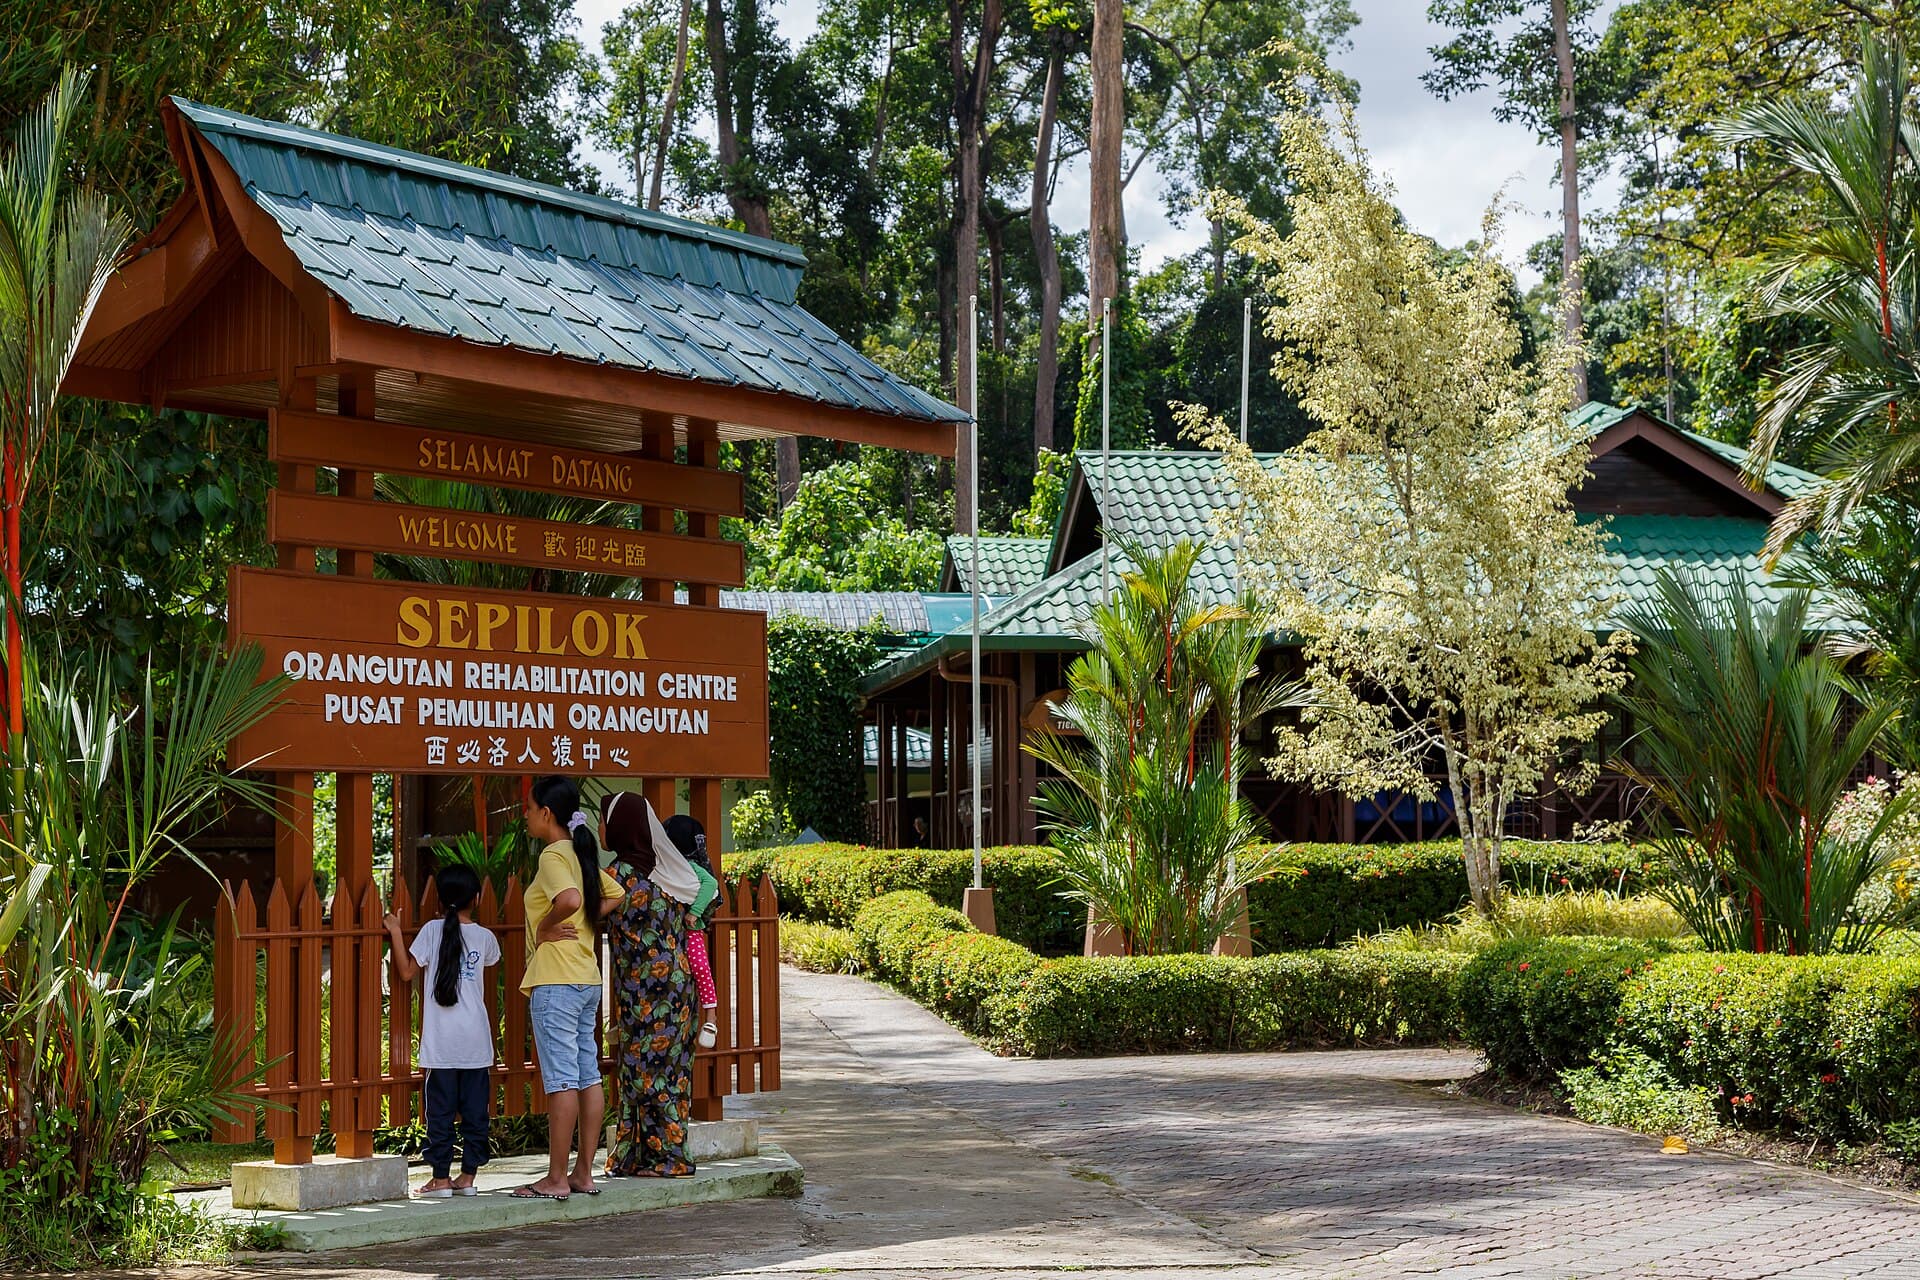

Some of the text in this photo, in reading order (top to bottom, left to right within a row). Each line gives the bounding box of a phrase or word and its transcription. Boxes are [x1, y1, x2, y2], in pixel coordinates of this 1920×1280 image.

[418, 437, 632, 493] SELAMAT DATANG
[398, 514, 517, 553] WELCOME
[543, 531, 646, 567] 歡迎光臨
[397, 596, 649, 660] SEPILOK
[283, 650, 737, 701] ORANGUTAN REHABILITATION CENTRE
[325, 693, 709, 734] PUSAT PEMULIHAN ORANGUTAN
[424, 735, 630, 770] 西必洛人猿中心
